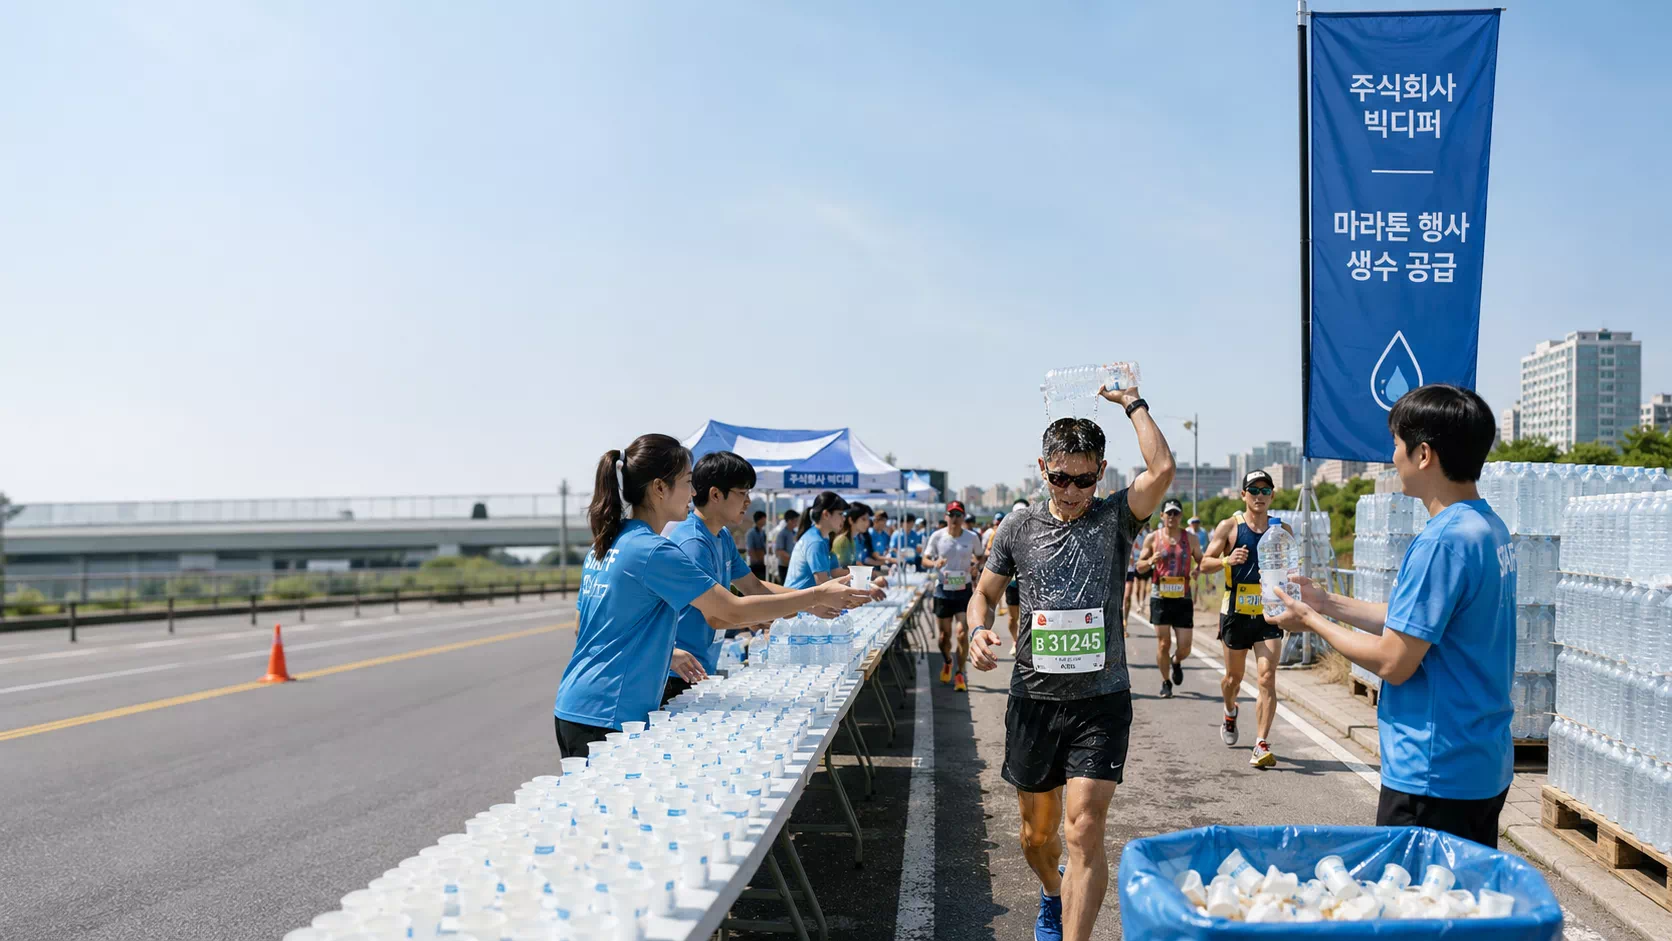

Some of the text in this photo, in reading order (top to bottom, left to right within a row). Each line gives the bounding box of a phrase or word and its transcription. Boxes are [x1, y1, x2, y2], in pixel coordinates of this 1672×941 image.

[1349, 73, 1457, 103] 주식회사
[1364, 109, 1441, 139] 빅디퍼
[1334, 210, 1470, 243] 마라톤 행사
[1346, 250, 1457, 283] 생수 공급
[1035, 632, 1101, 652] B 31245
